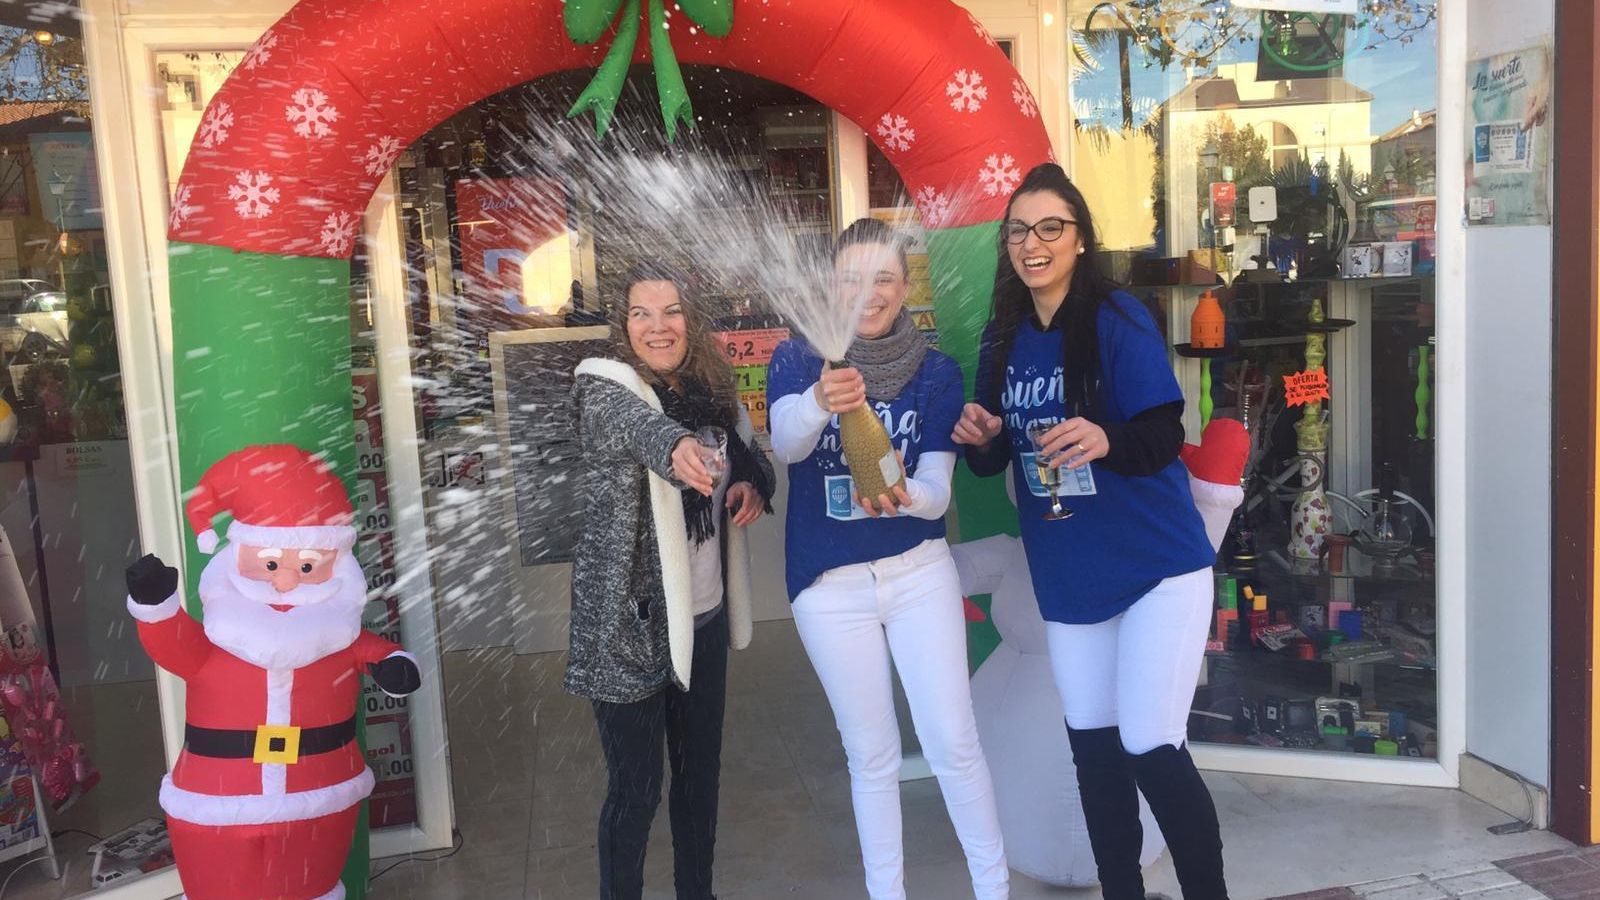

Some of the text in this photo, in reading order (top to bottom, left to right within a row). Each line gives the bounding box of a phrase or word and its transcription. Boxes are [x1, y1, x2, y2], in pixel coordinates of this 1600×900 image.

[1472, 71, 1489, 91] La
[1491, 55, 1521, 81] suerte
[1001, 365, 1066, 410] Sueñ
[1293, 375, 1318, 385] OFERTA
